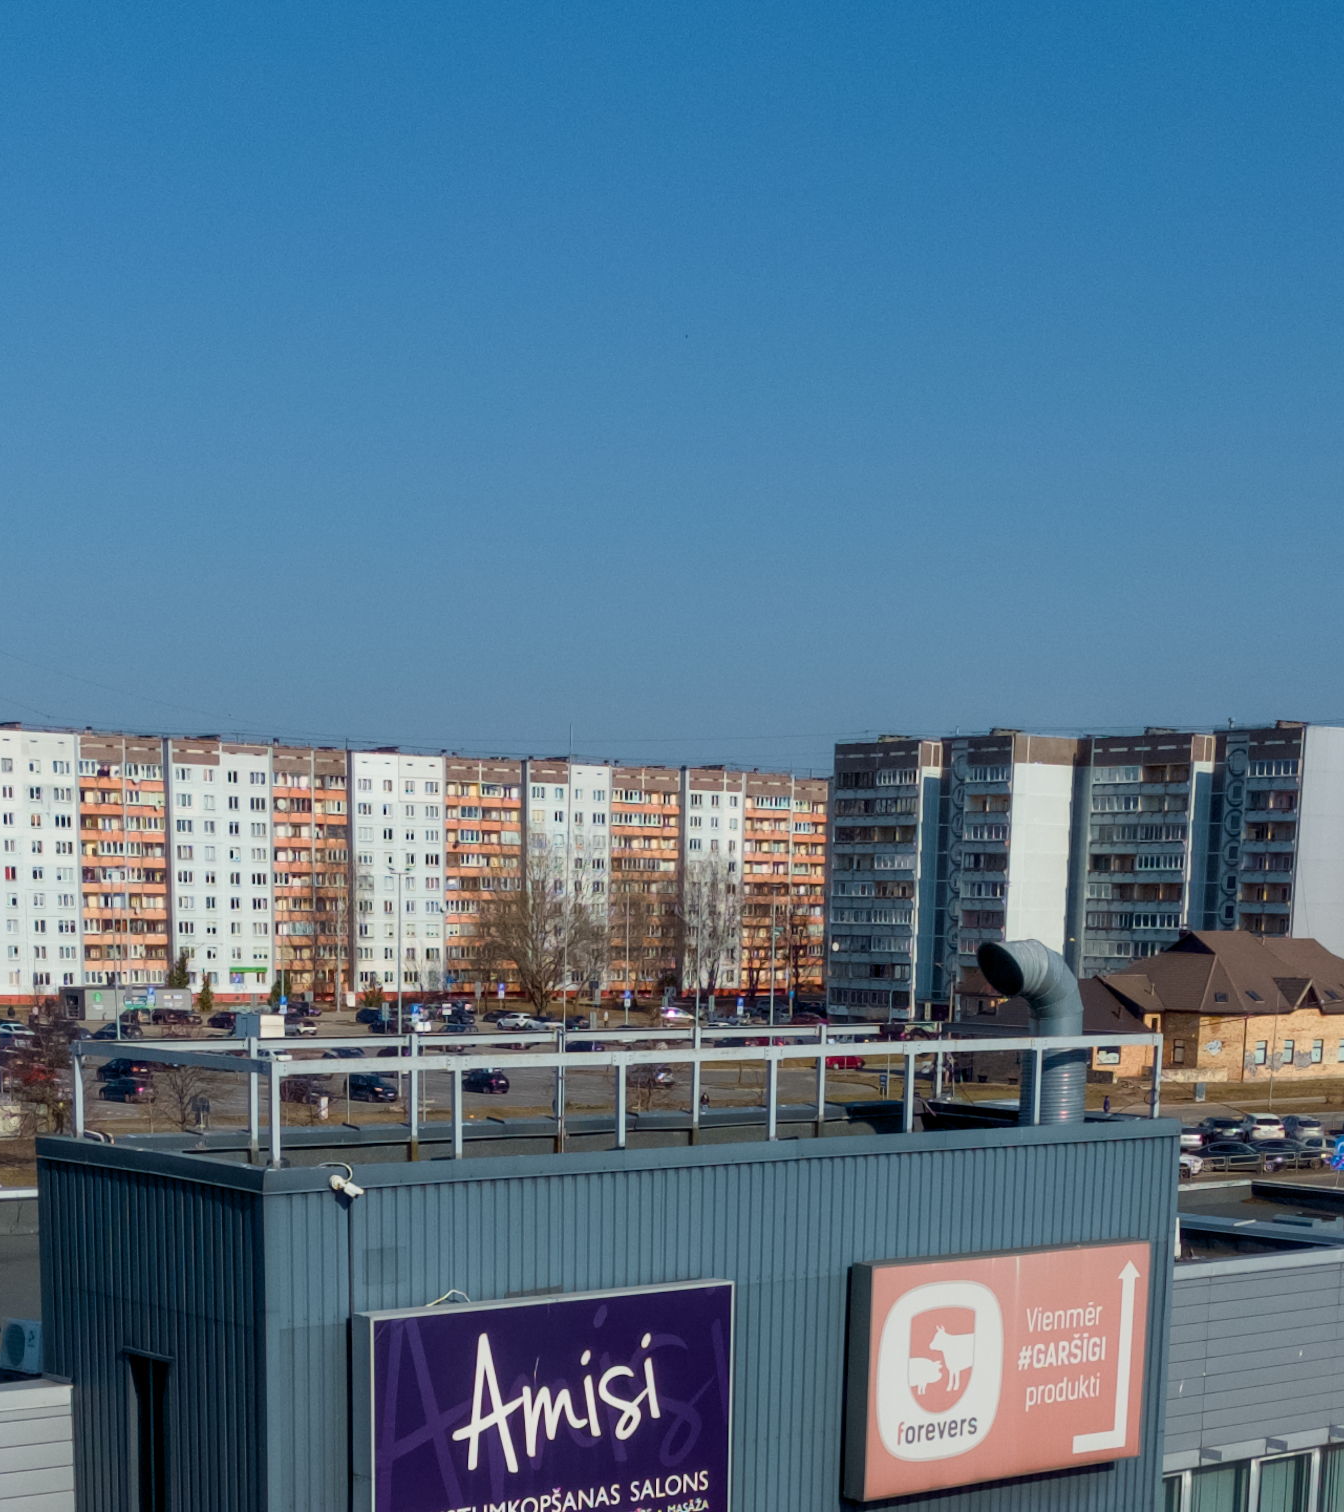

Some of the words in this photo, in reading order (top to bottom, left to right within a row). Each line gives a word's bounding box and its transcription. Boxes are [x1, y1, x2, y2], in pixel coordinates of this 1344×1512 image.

[1026, 1302, 1103, 1333] Vienmēr
[1017, 1333, 1107, 1371] #GARŠĪGI
[452, 1332, 661, 1473] Amisi
[1025, 1372, 1101, 1412] produkti
[896, 1416, 978, 1446] forevers
[630, 1470, 709, 1502] SALONS
